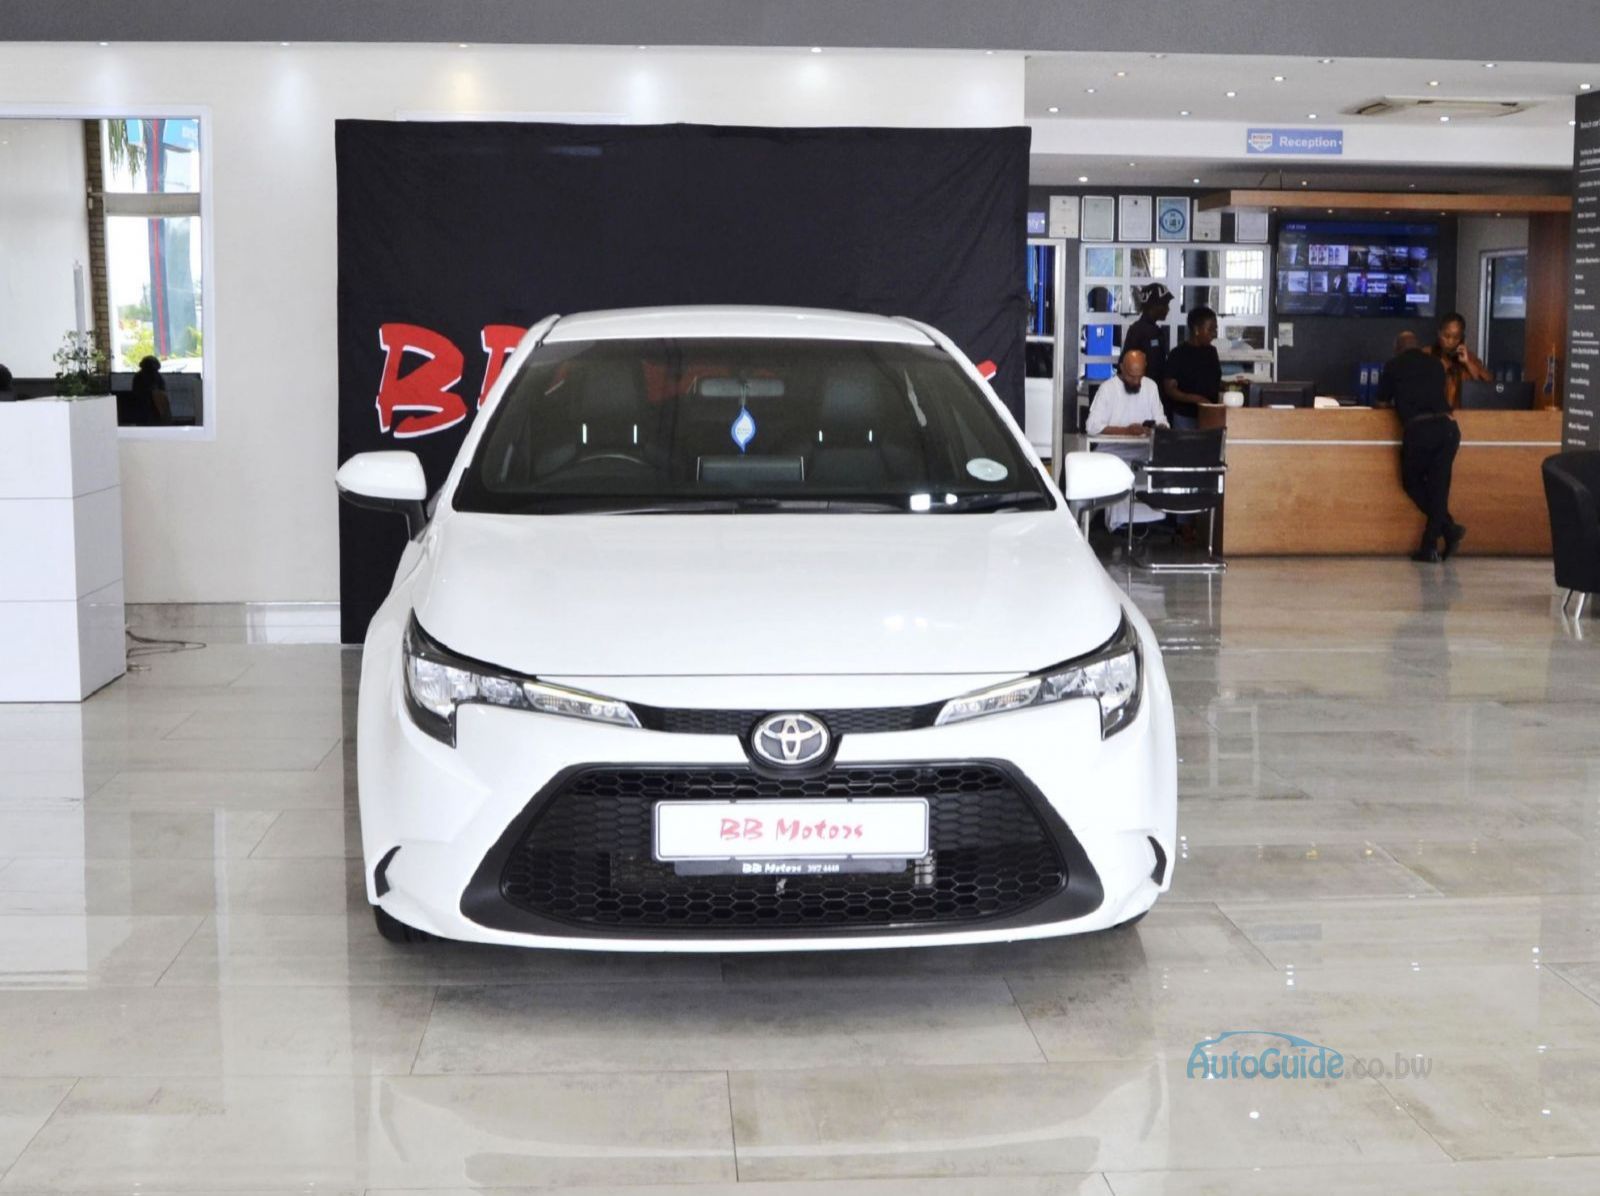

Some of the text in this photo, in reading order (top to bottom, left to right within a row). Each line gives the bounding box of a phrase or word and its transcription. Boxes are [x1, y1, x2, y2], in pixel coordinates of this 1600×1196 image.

[1279, 135, 1337, 149] Reception
[720, 819, 863, 841] BB Motors
[742, 863, 762, 874] BB
[764, 863, 802, 874] Motors
